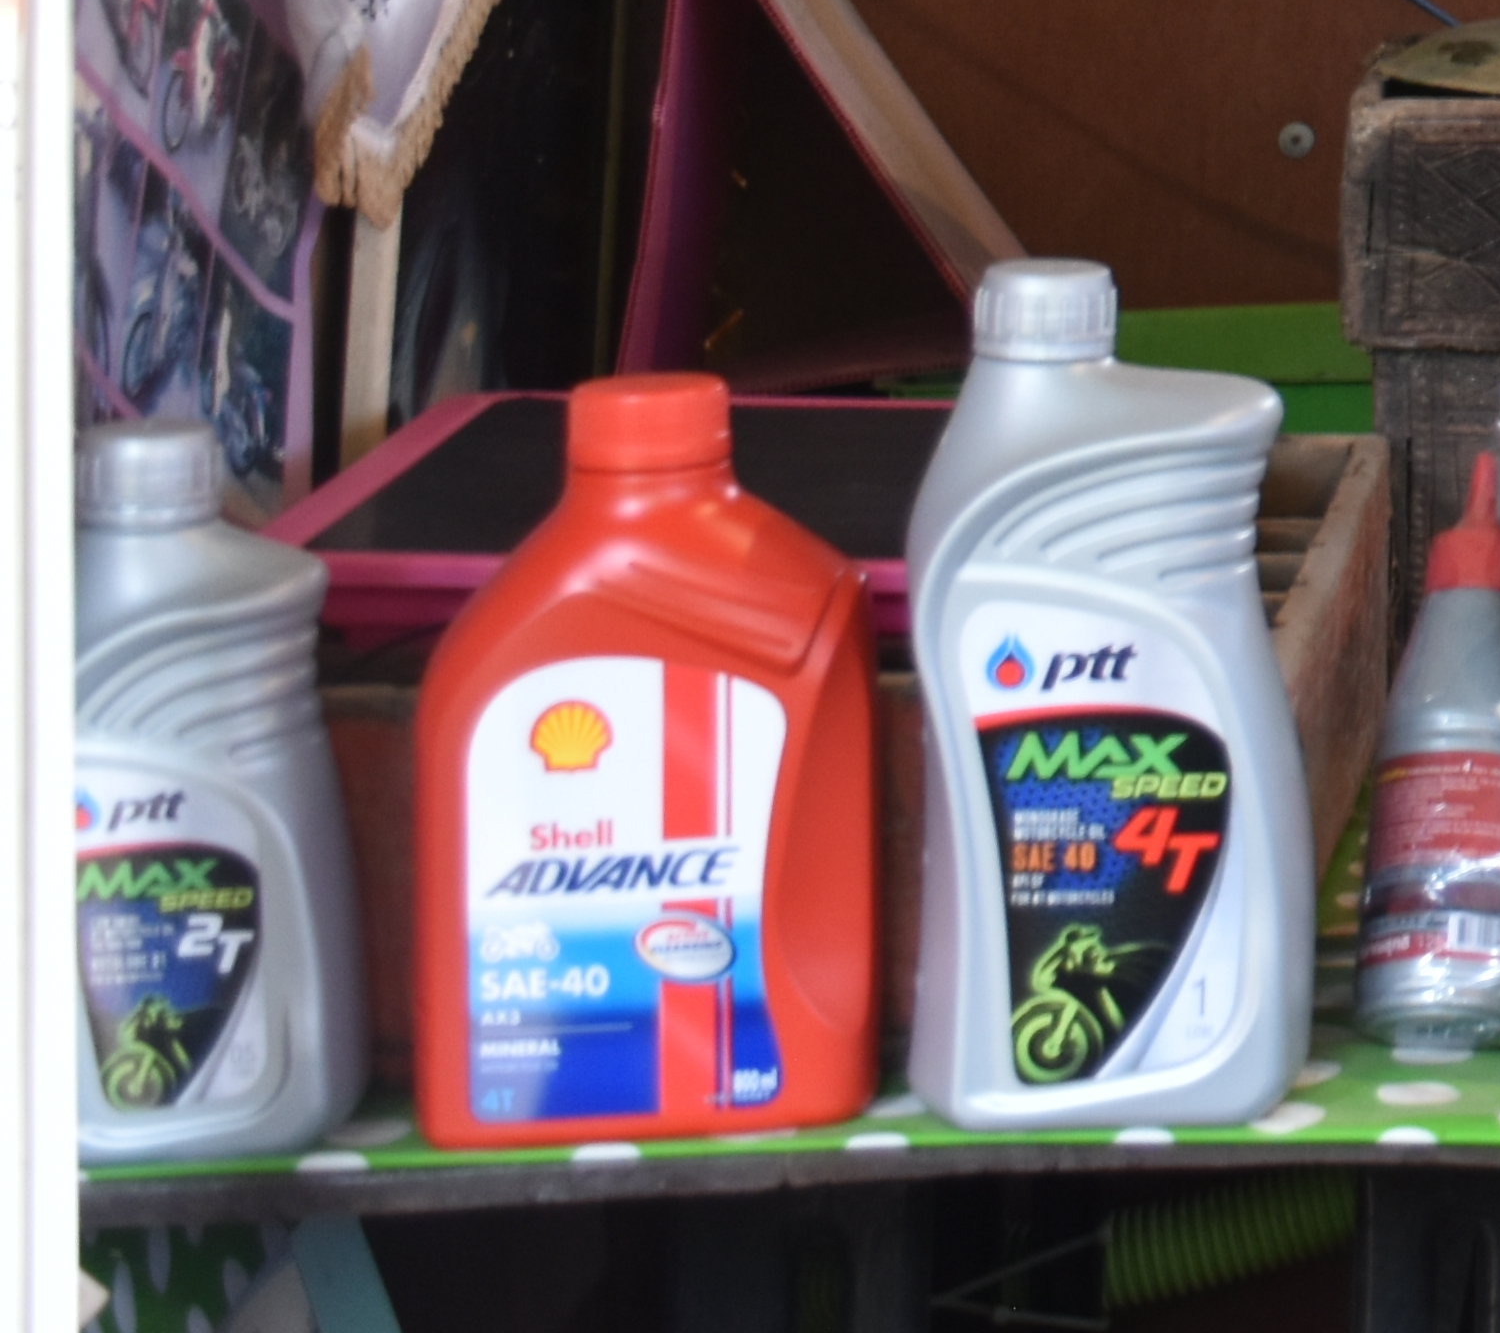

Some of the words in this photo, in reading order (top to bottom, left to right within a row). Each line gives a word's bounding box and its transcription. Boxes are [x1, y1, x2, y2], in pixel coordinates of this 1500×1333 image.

[1040, 643, 1138, 692] ptt
[1007, 731, 1190, 780] MAX
[1110, 773, 1229, 800] SPEED
[108, 790, 186, 831] ptt
[529, 818, 615, 851] Shell
[1112, 805, 1221, 895] 4T
[484, 845, 741, 899] ADVANCE
[1012, 840, 1057, 874] SAE
[1064, 840, 1097, 874] 40
[76, 857, 219, 902] MAX
[158, 885, 254, 915] SPEED
[177, 912, 255, 976] 2T
[479, 963, 611, 1004] SAE-40
